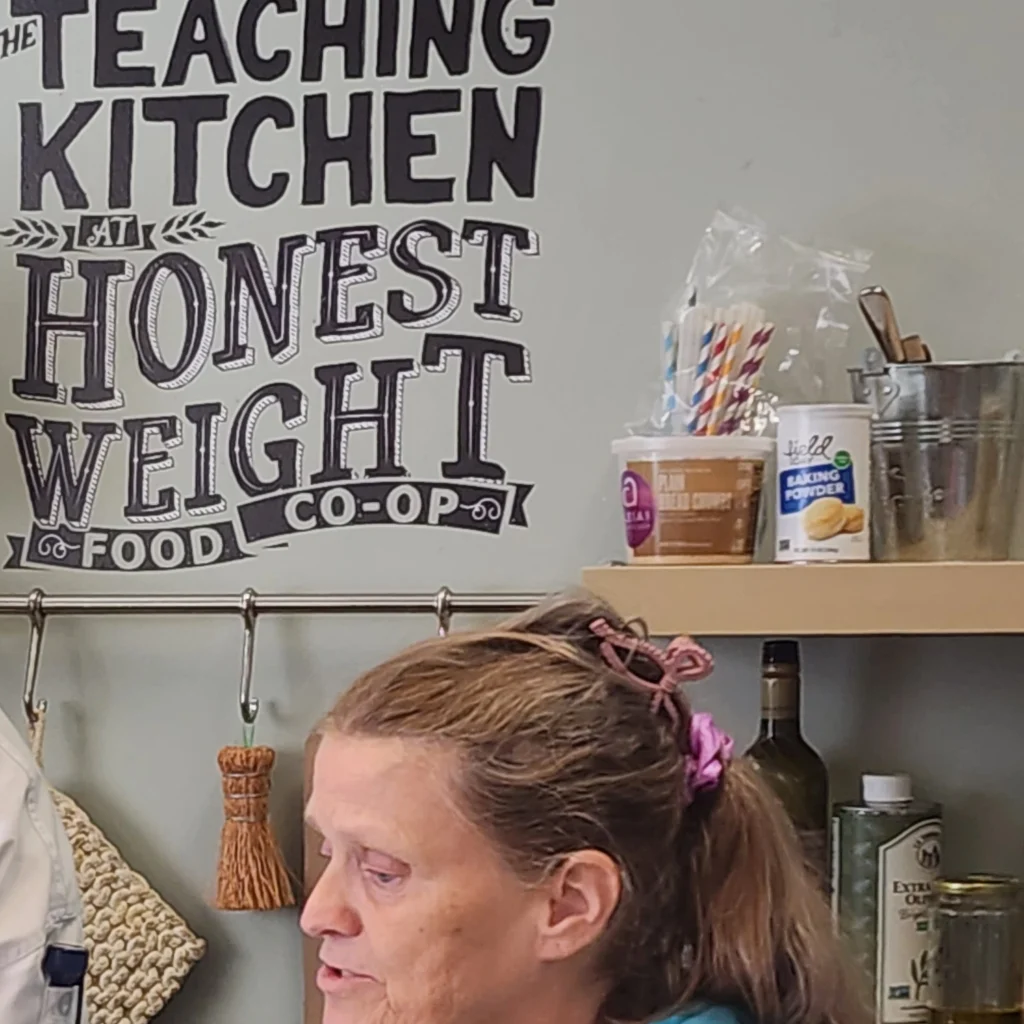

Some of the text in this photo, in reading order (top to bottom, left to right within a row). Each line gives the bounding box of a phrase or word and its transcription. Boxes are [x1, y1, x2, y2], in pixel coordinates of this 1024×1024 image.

[10, 0, 556, 89] TEACHING
[18, 87, 543, 212] KITCHEN
[85, 216, 137, 247] AT
[12, 219, 540, 411] HONEST
[5, 333, 534, 530] WEIGHT
[784, 482, 846, 501] POWDER
[786, 469, 841, 487] BAKING
[82, 487, 461, 571] FOOD CO-OP
